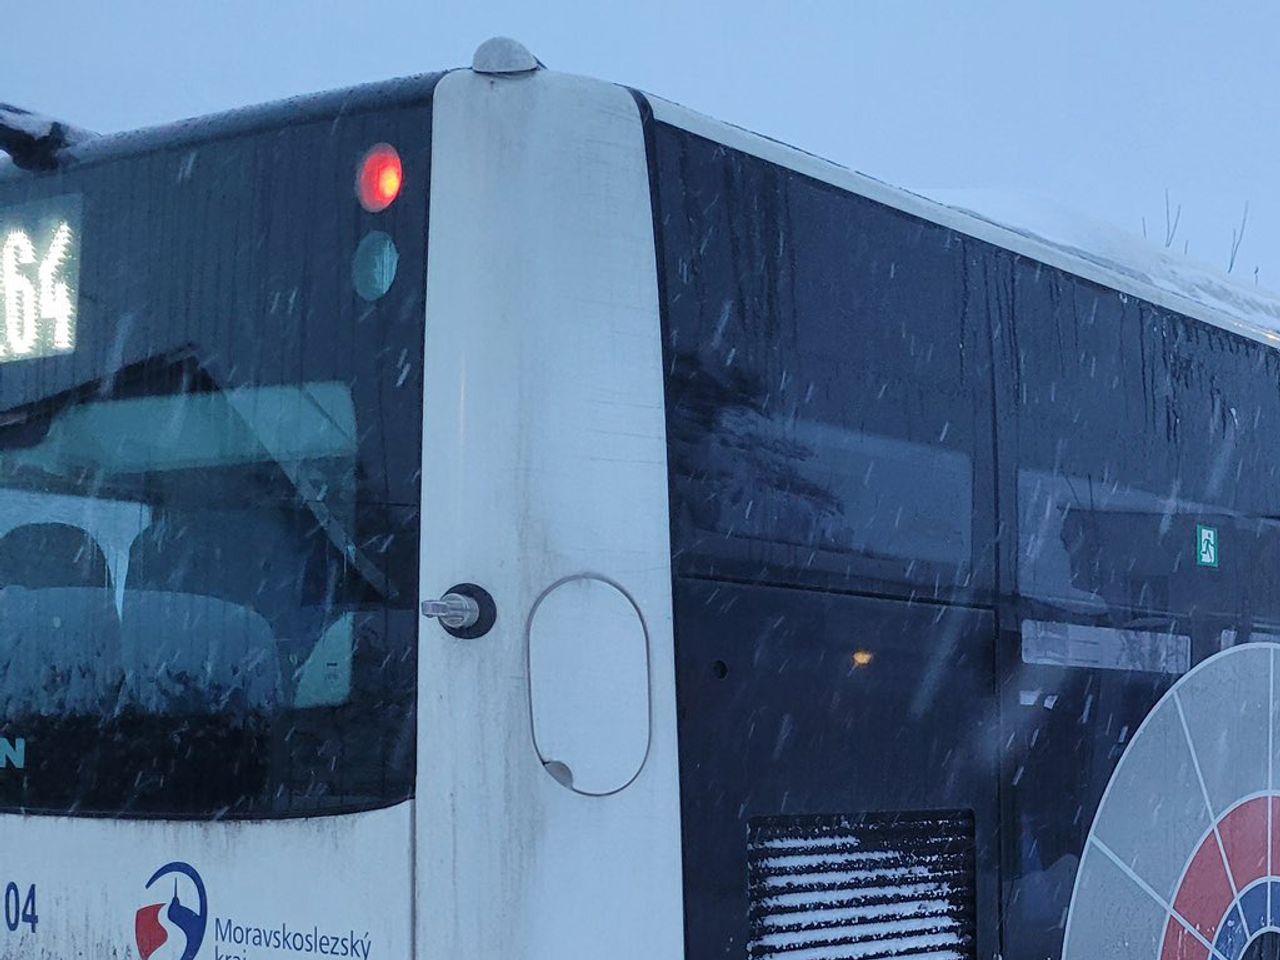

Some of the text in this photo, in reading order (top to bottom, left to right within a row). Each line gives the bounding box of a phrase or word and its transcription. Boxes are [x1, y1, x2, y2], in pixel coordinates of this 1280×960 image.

[0, 222, 74, 357] 64
[0, 738, 25, 769] N
[5, 882, 39, 933] 04
